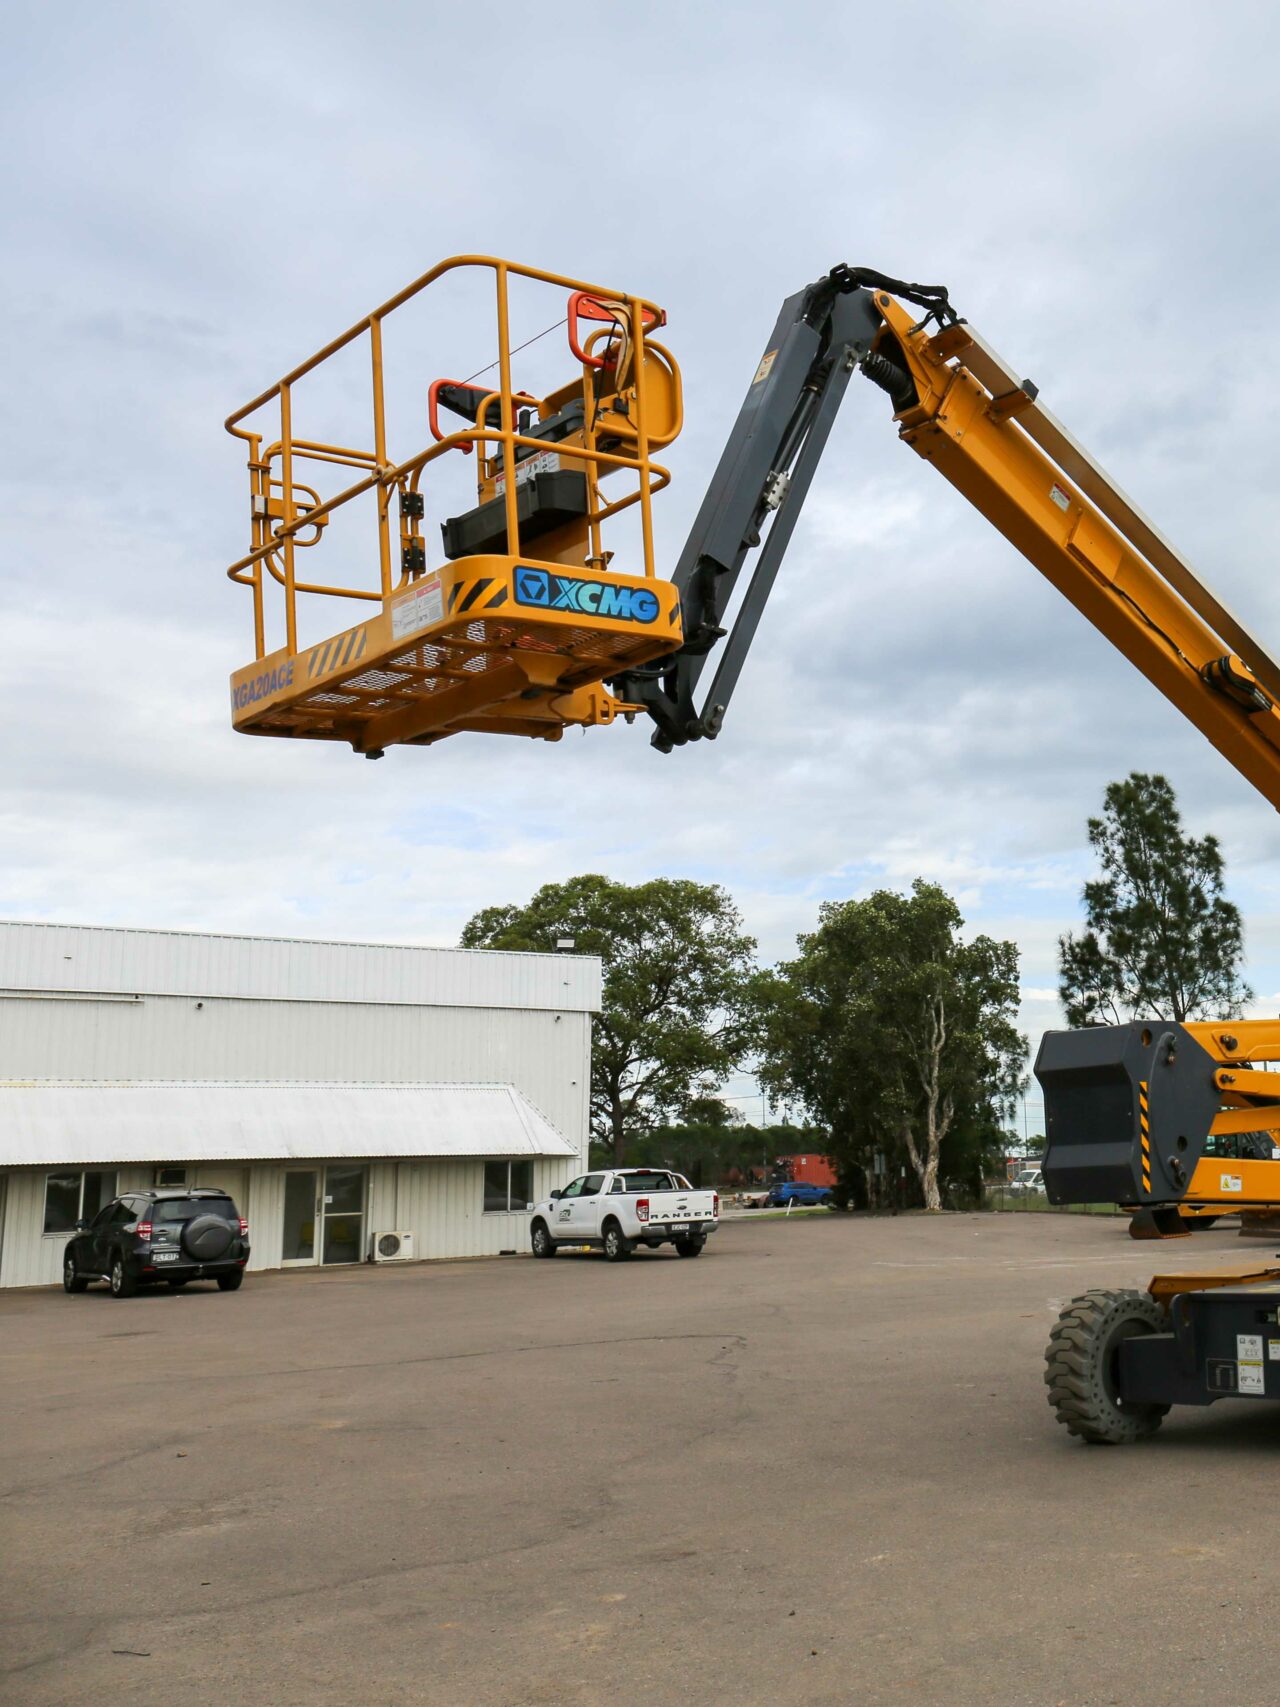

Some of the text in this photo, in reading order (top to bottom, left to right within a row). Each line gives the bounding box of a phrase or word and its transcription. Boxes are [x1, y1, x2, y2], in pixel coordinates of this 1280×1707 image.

[550, 578, 659, 622] XCMG
[233, 661, 294, 709] XGA20ACE
[650, 1210, 712, 1220] RANGER
